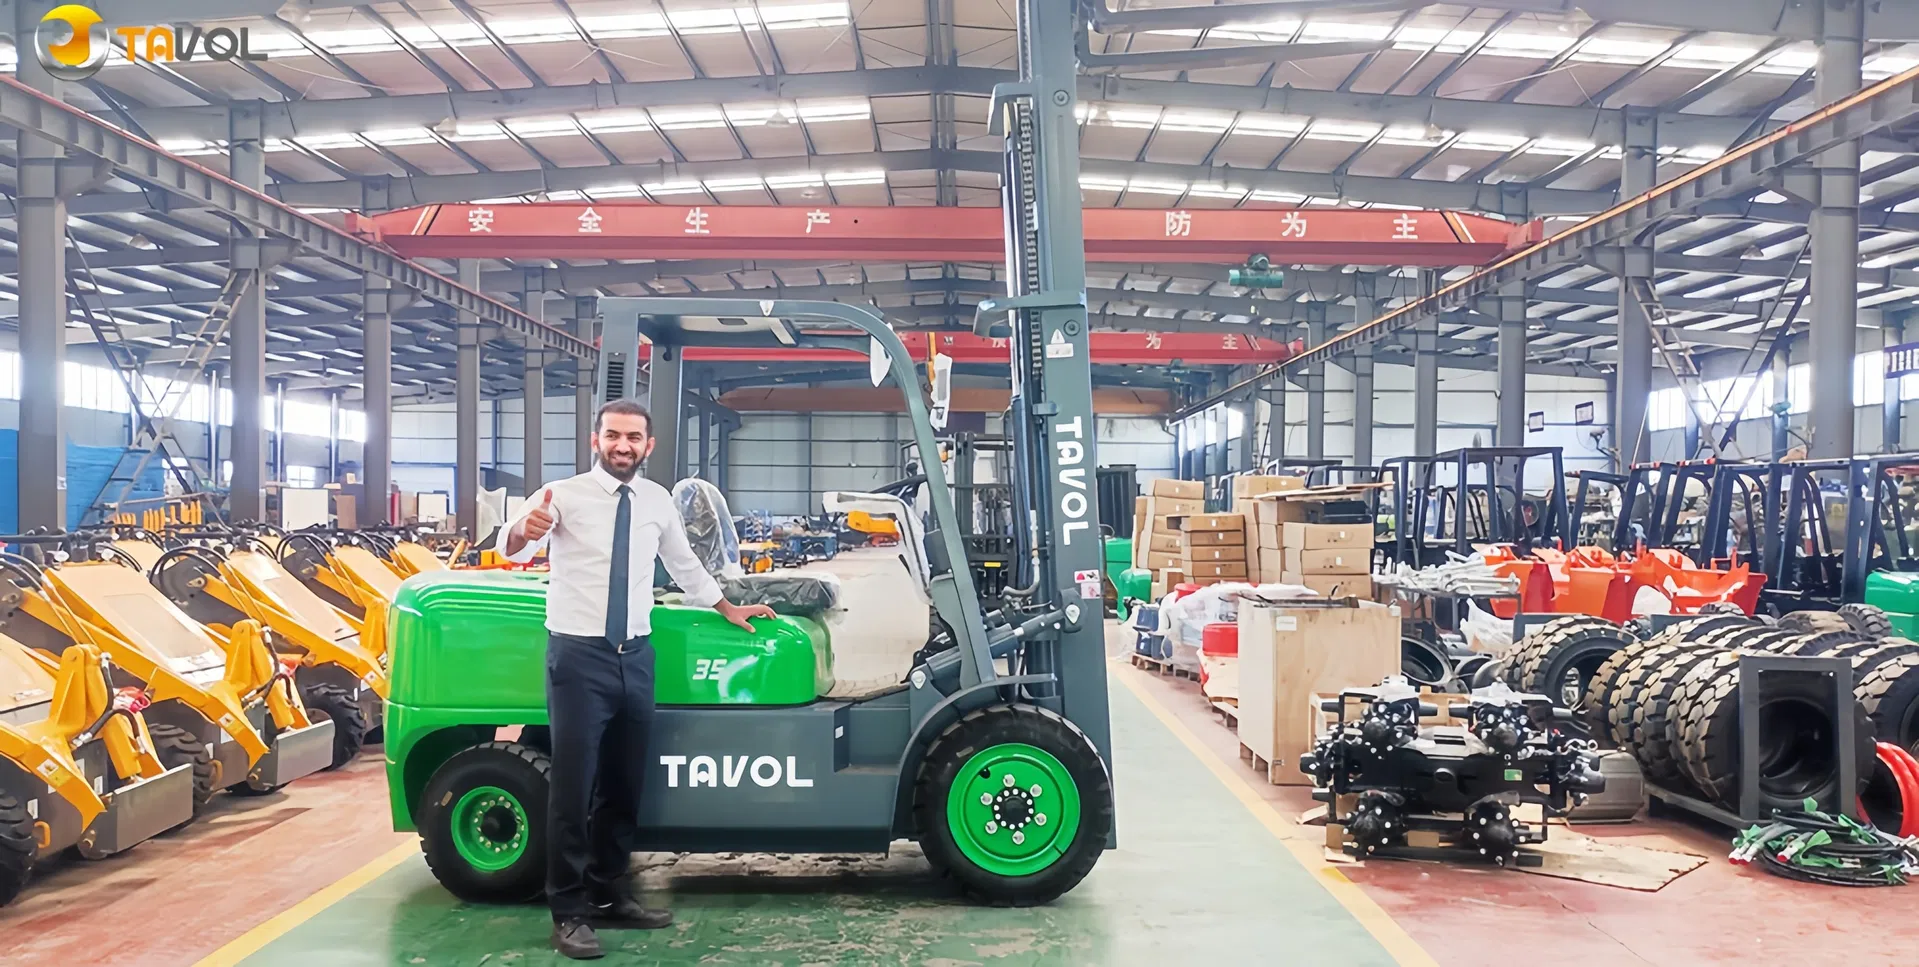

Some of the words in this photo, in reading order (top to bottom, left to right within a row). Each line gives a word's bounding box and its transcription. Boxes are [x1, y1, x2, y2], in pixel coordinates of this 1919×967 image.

[468, 207, 831, 234] 安全生产
[1055, 415, 1089, 546] TAVOL
[692, 658, 728, 681] 35
[659, 755, 814, 788] TAVOL
